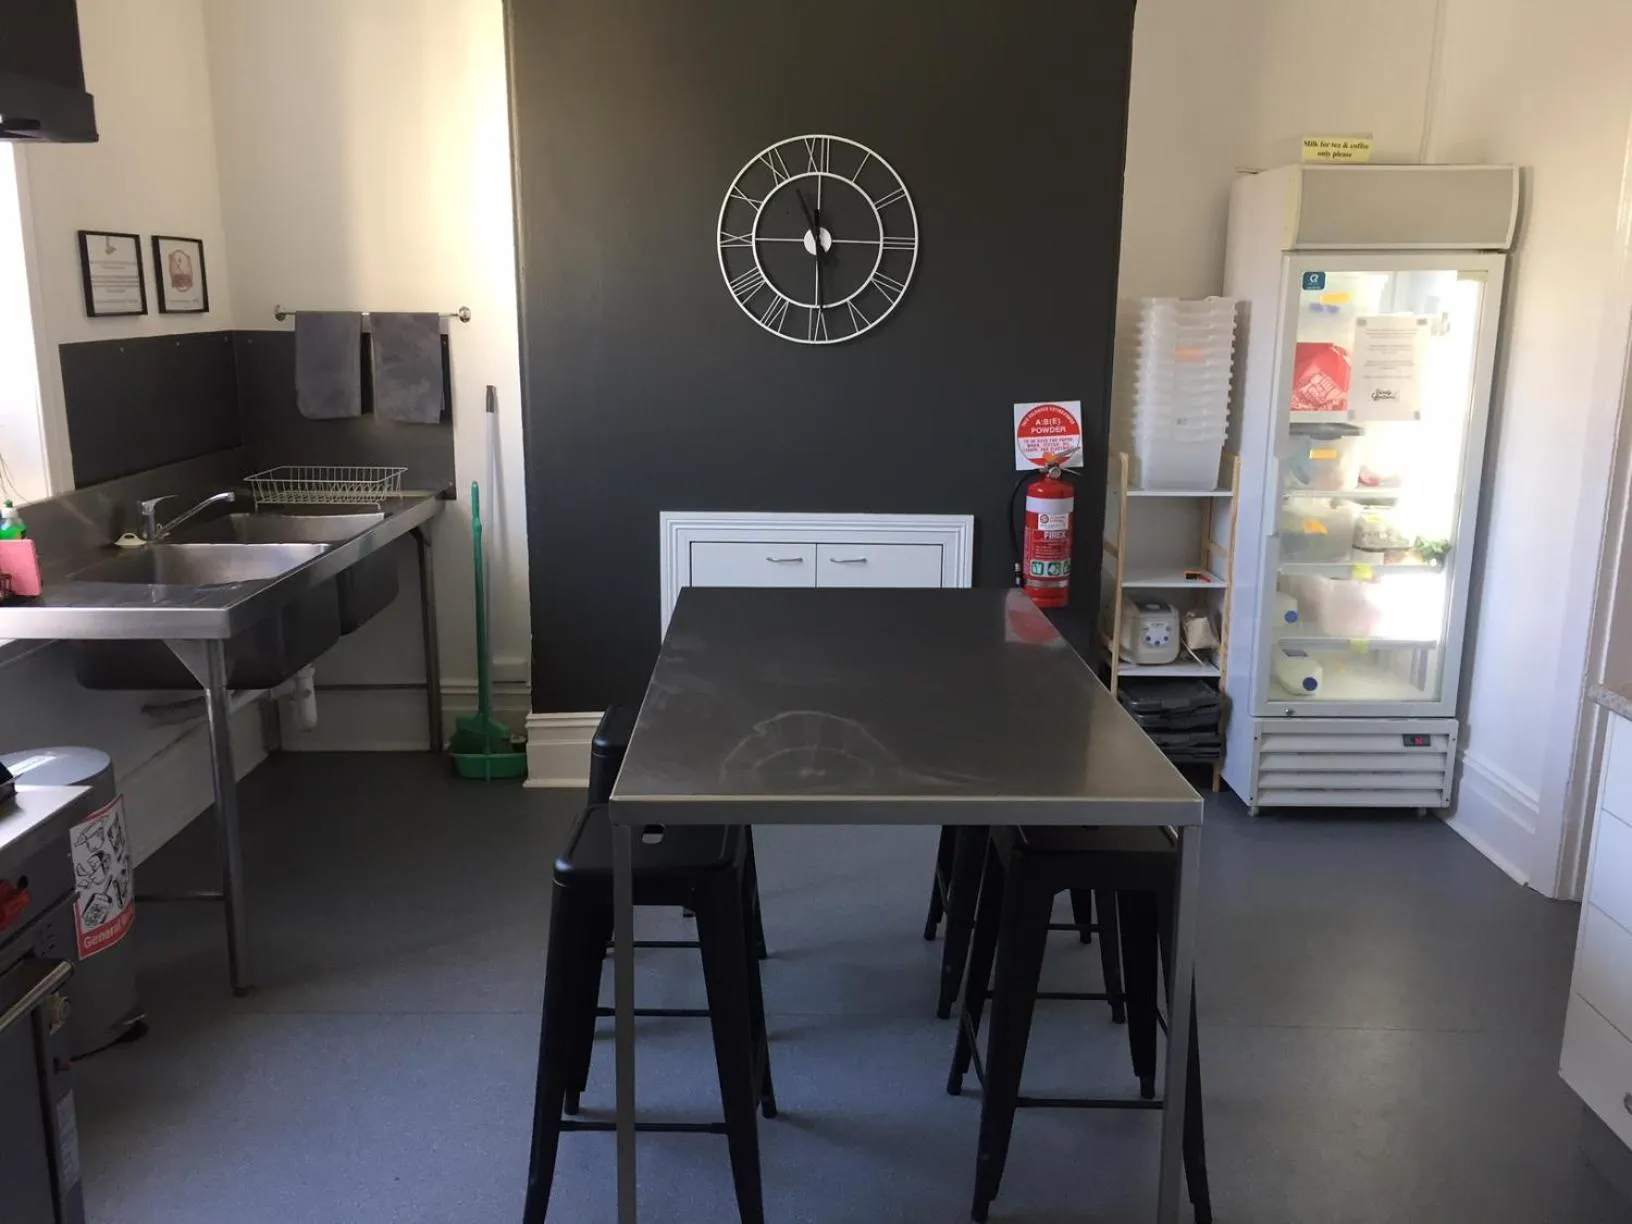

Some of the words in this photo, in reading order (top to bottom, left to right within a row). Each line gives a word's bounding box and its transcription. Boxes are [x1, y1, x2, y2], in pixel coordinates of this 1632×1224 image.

[1303, 140, 1318, 148] Milk
[1350, 142, 1369, 150] coffee
[1332, 151, 1352, 159] please
[805, 137, 830, 174] XII
[84, 919, 120, 949] General
